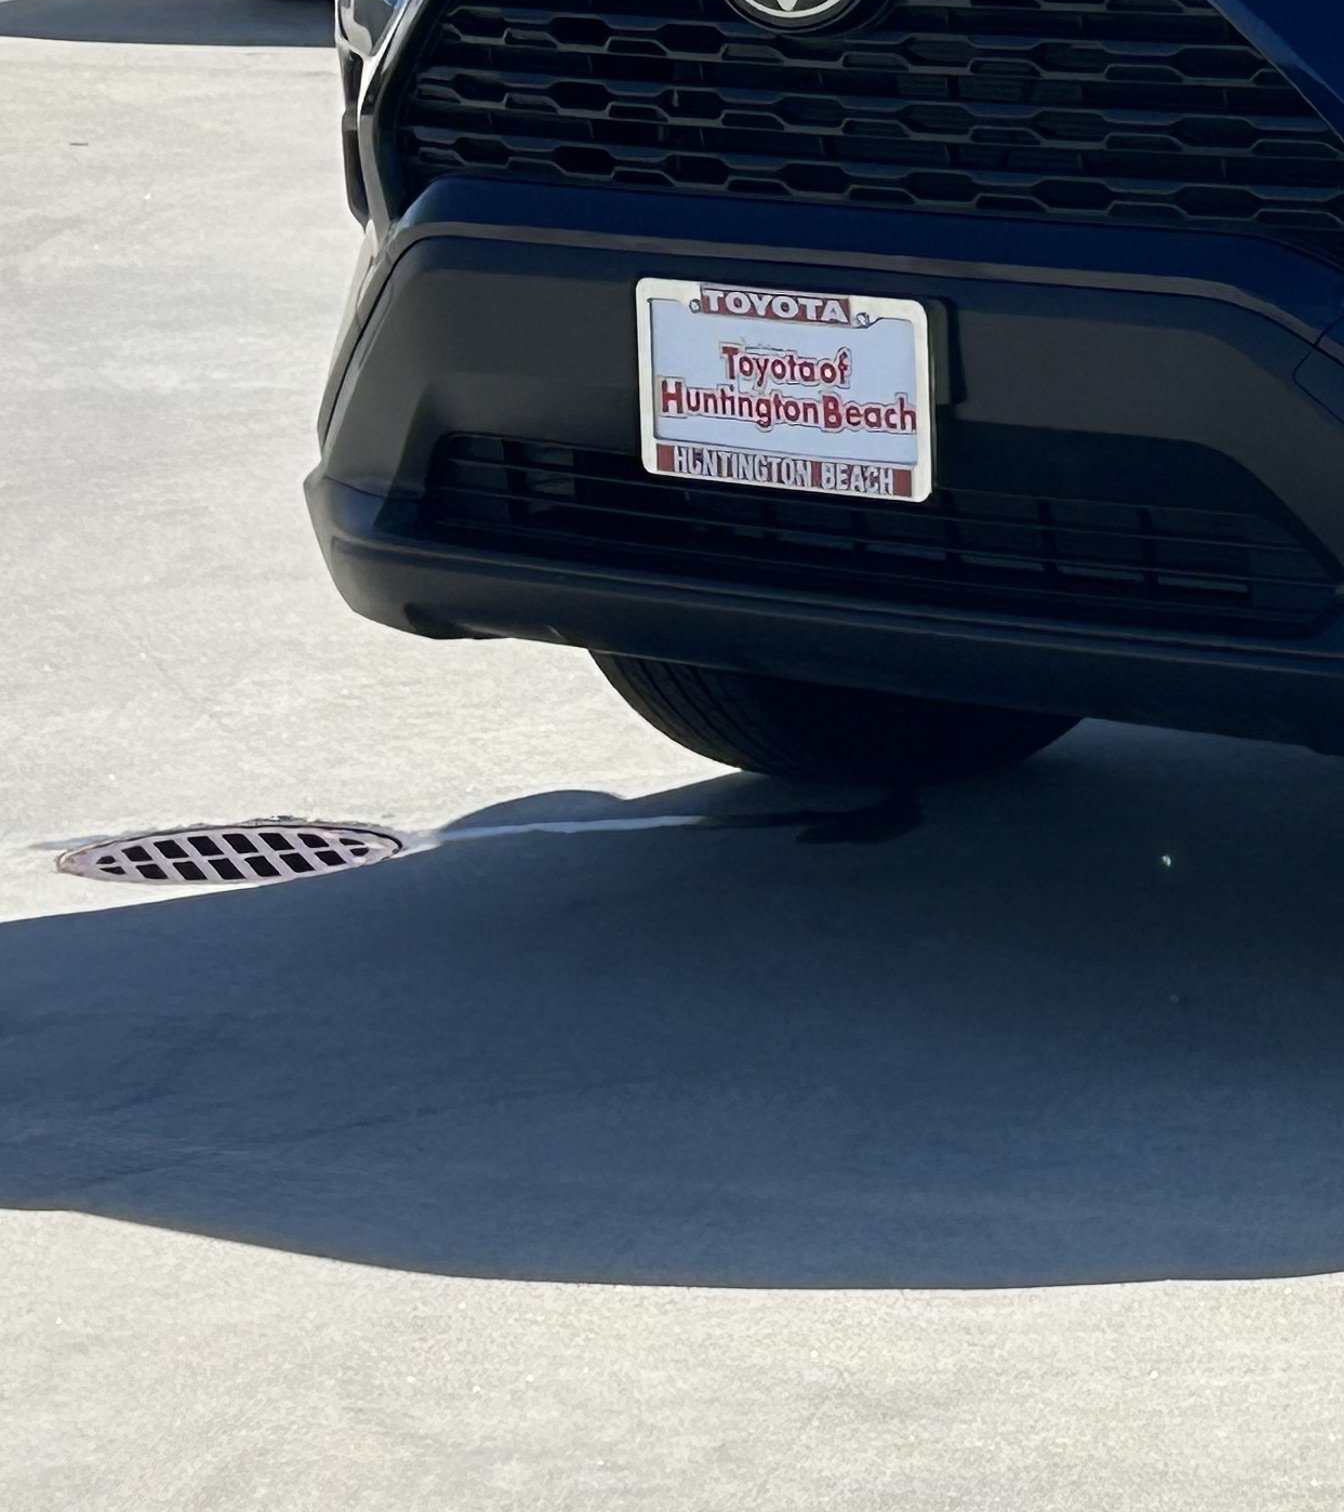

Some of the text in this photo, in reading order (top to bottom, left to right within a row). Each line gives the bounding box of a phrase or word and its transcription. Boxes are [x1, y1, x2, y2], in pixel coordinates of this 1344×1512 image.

[702, 290, 849, 323] TOYOTA
[721, 346, 849, 387] Toyota of
[660, 379, 917, 431] Huntington Beach
[673, 445, 894, 495] HUNTINGTON BEACH
